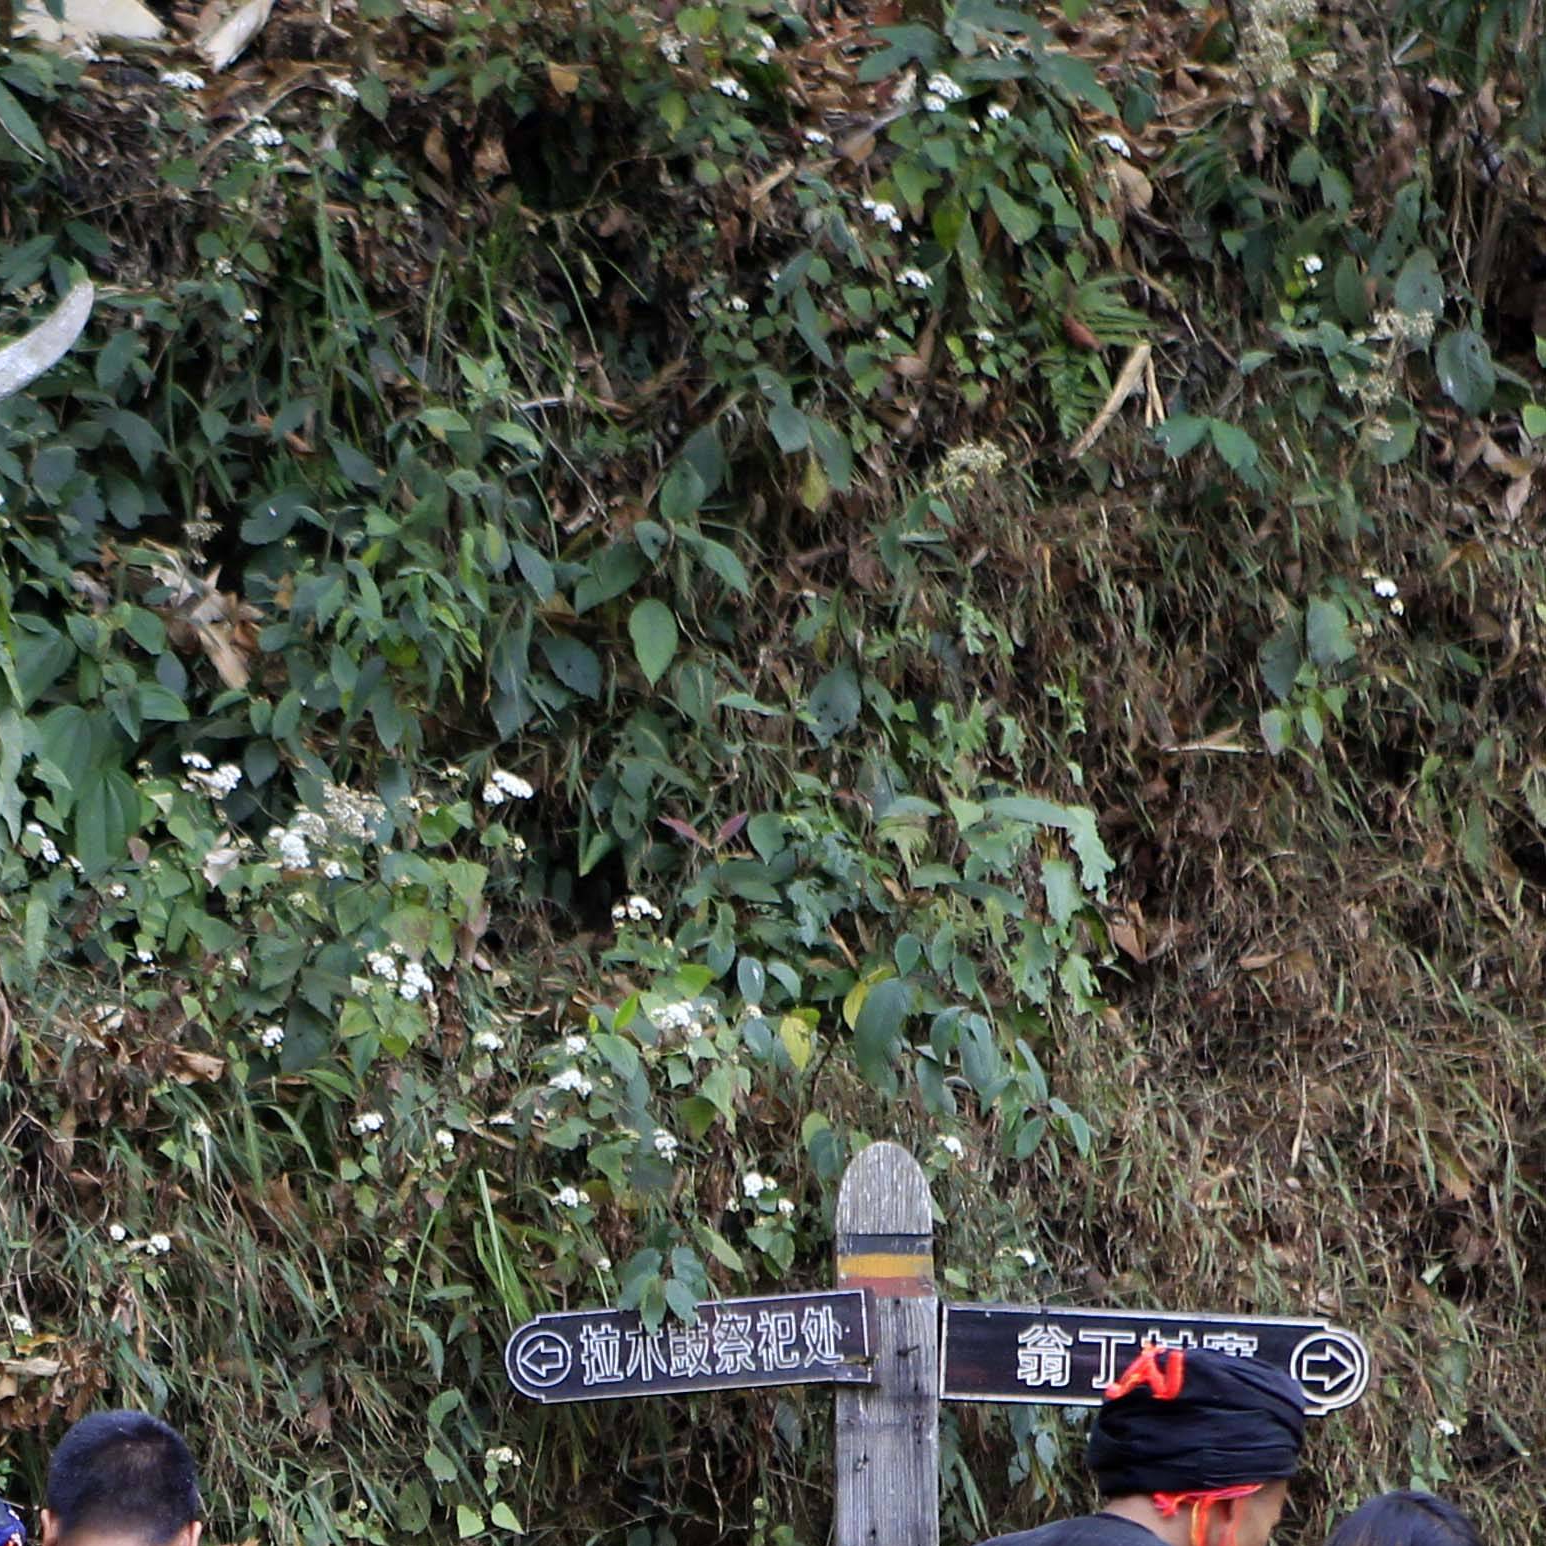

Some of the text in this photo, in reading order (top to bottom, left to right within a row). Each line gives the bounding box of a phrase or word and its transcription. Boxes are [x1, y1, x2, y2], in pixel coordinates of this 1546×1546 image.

[580, 1305, 845, 1386] 拉木鼓祭祀处
